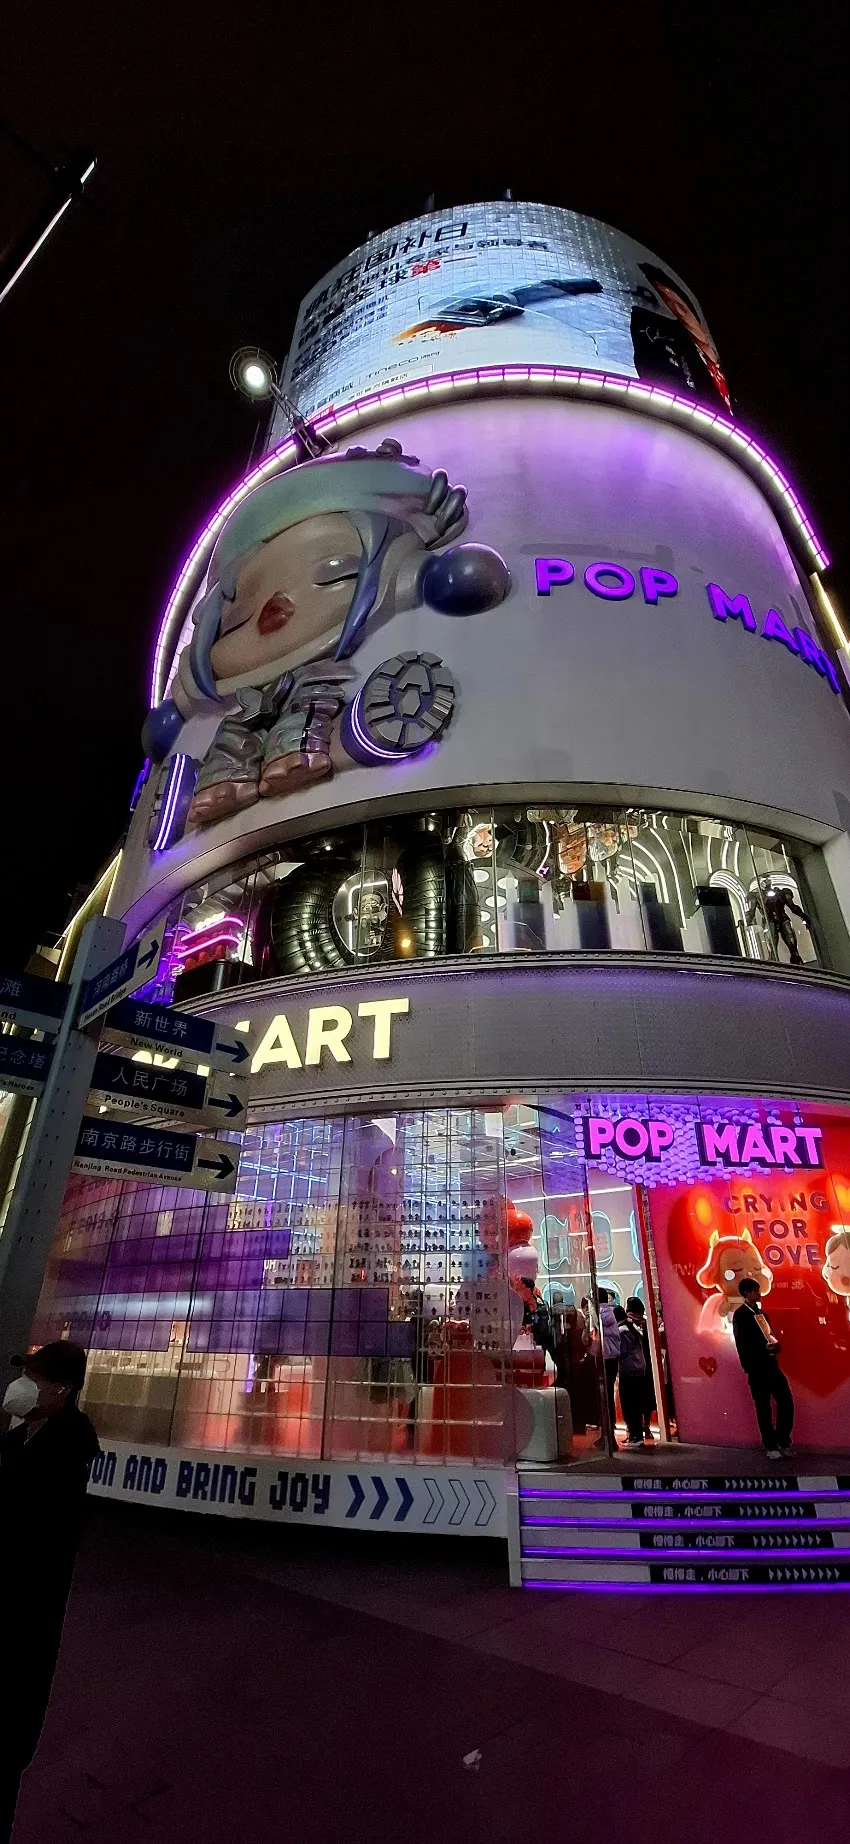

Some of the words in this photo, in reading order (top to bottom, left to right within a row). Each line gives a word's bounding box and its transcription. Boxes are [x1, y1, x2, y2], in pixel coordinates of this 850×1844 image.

[535, 557, 679, 606] POP
[706, 581, 841, 695] MART
[133, 1009, 189, 1038] 新世界
[197, 998, 410, 1077] ART
[130, 1036, 152, 1050] New
[155, 1043, 183, 1058] World
[111, 1066, 189, 1097] 人民广场
[104, 1094, 148, 1112] People's
[150, 1103, 185, 1118] Square
[80, 1128, 191, 1162] 南京路步行街
[588, 1116, 675, 1161] POP
[700, 1123, 822, 1166] MART
[74, 1160, 102, 1172] Nanjing
[104, 1166, 123, 1175] Road
[122, 1168, 158, 1179] Pedestrian
[725, 1191, 829, 1214] CRYING
[752, 1218, 809, 1240] FOR
[764, 1244, 823, 1266] OVE
[122, 1454, 166, 1495] AND
[175, 1460, 258, 1506] BRING
[268, 1470, 331, 1514] JOY
